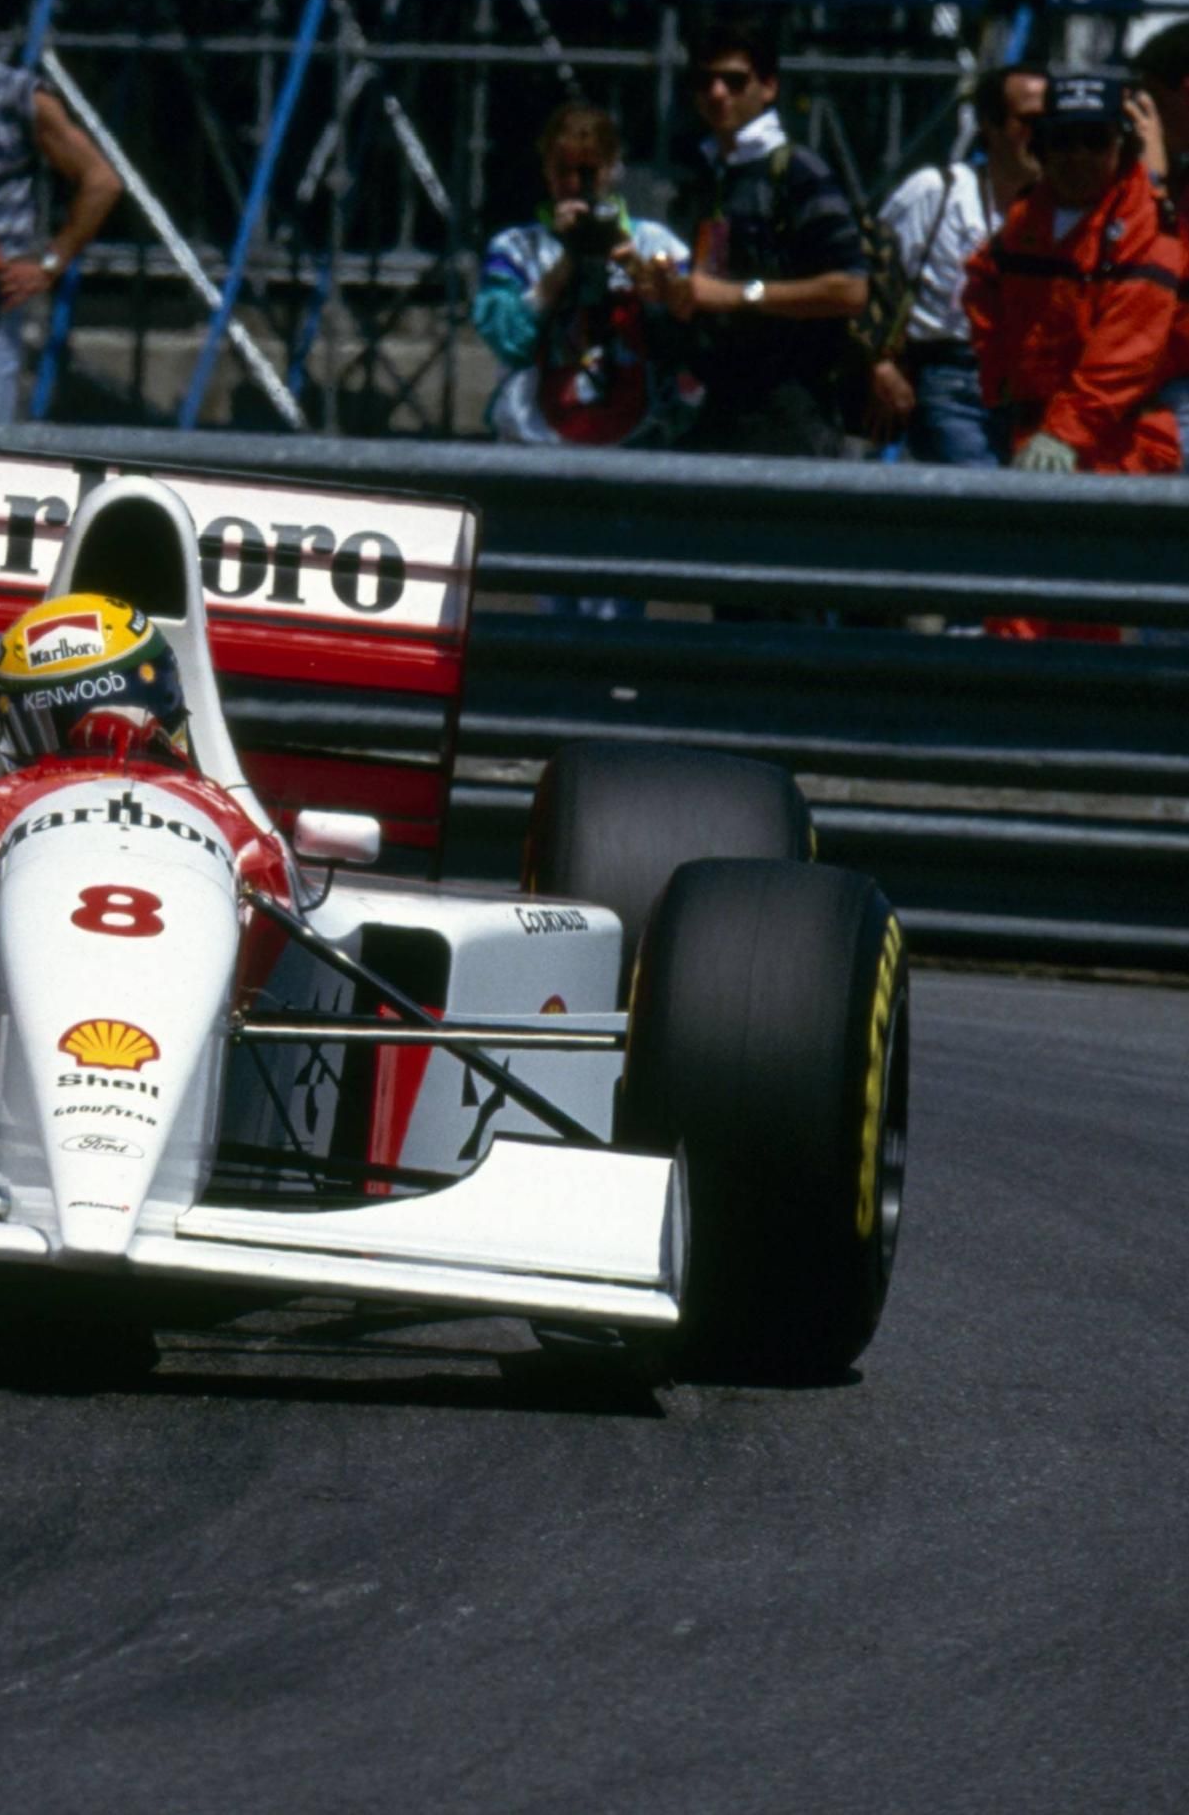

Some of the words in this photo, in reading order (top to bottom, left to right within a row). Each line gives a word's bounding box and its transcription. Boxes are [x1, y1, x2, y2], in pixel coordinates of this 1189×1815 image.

[30, 638, 102, 667] Marlboro
[23, 672, 127, 711] KENWOOD
[70, 884, 165, 937] 8
[57, 1073, 160, 1099] Shell
[53, 1104, 157, 1127] GOODYEAR
[78, 1135, 129, 1154] Ford
